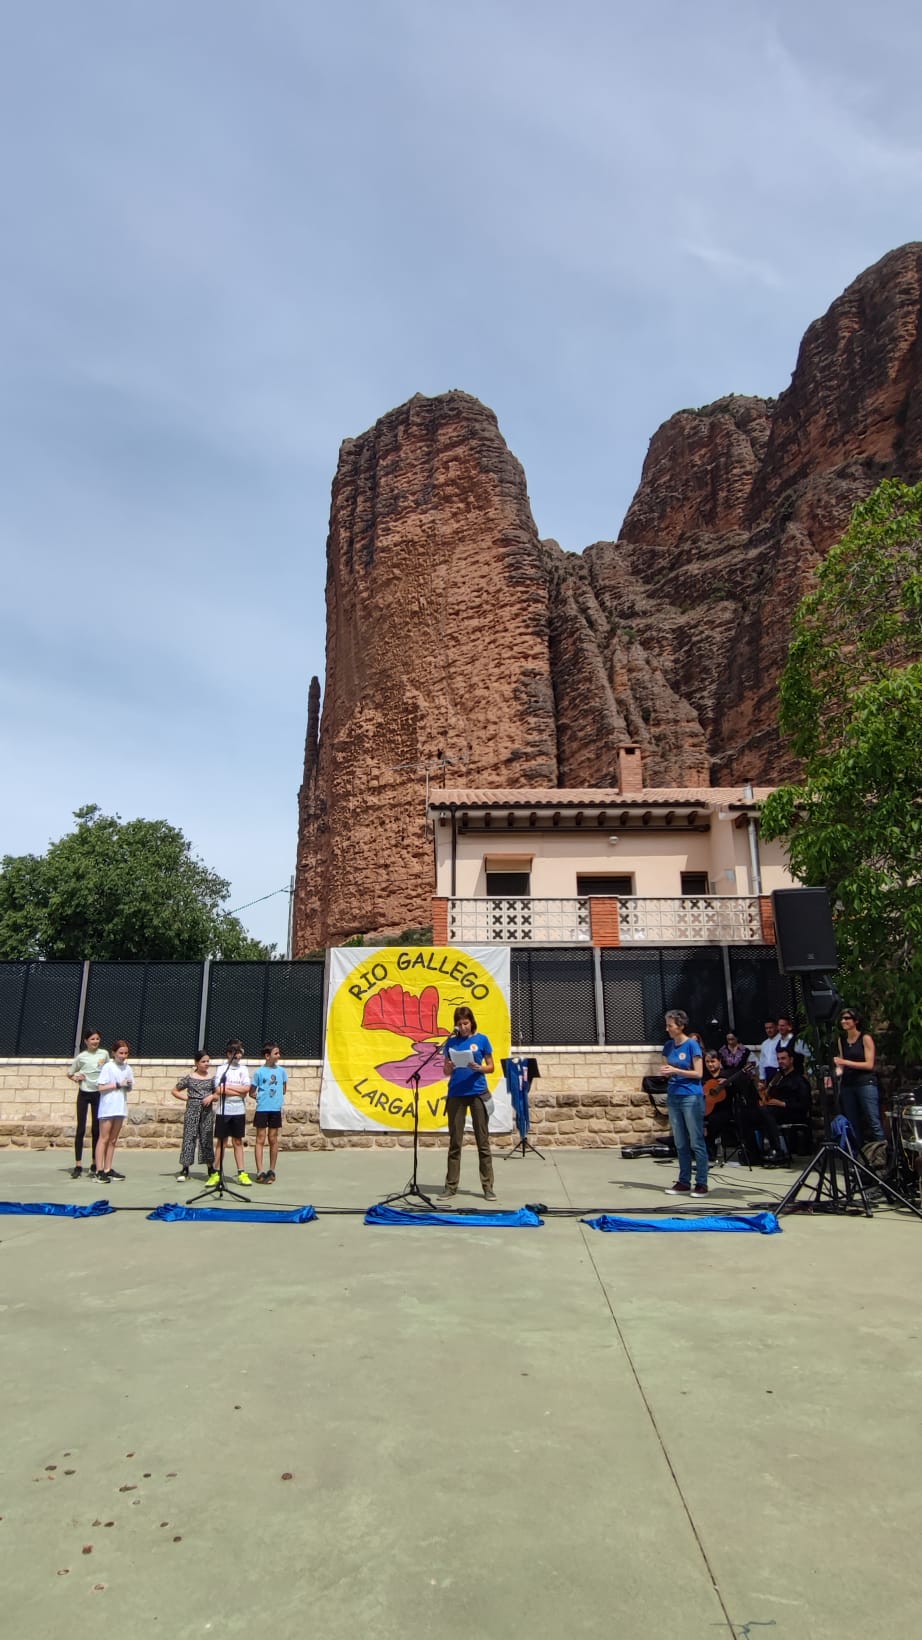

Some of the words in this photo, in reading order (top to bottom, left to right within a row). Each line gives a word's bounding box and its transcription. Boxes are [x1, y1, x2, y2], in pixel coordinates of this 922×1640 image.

[348, 963, 388, 1001] RIO
[397, 952, 489, 1001] GALLEGO
[353, 1078, 416, 1118] LARGA
